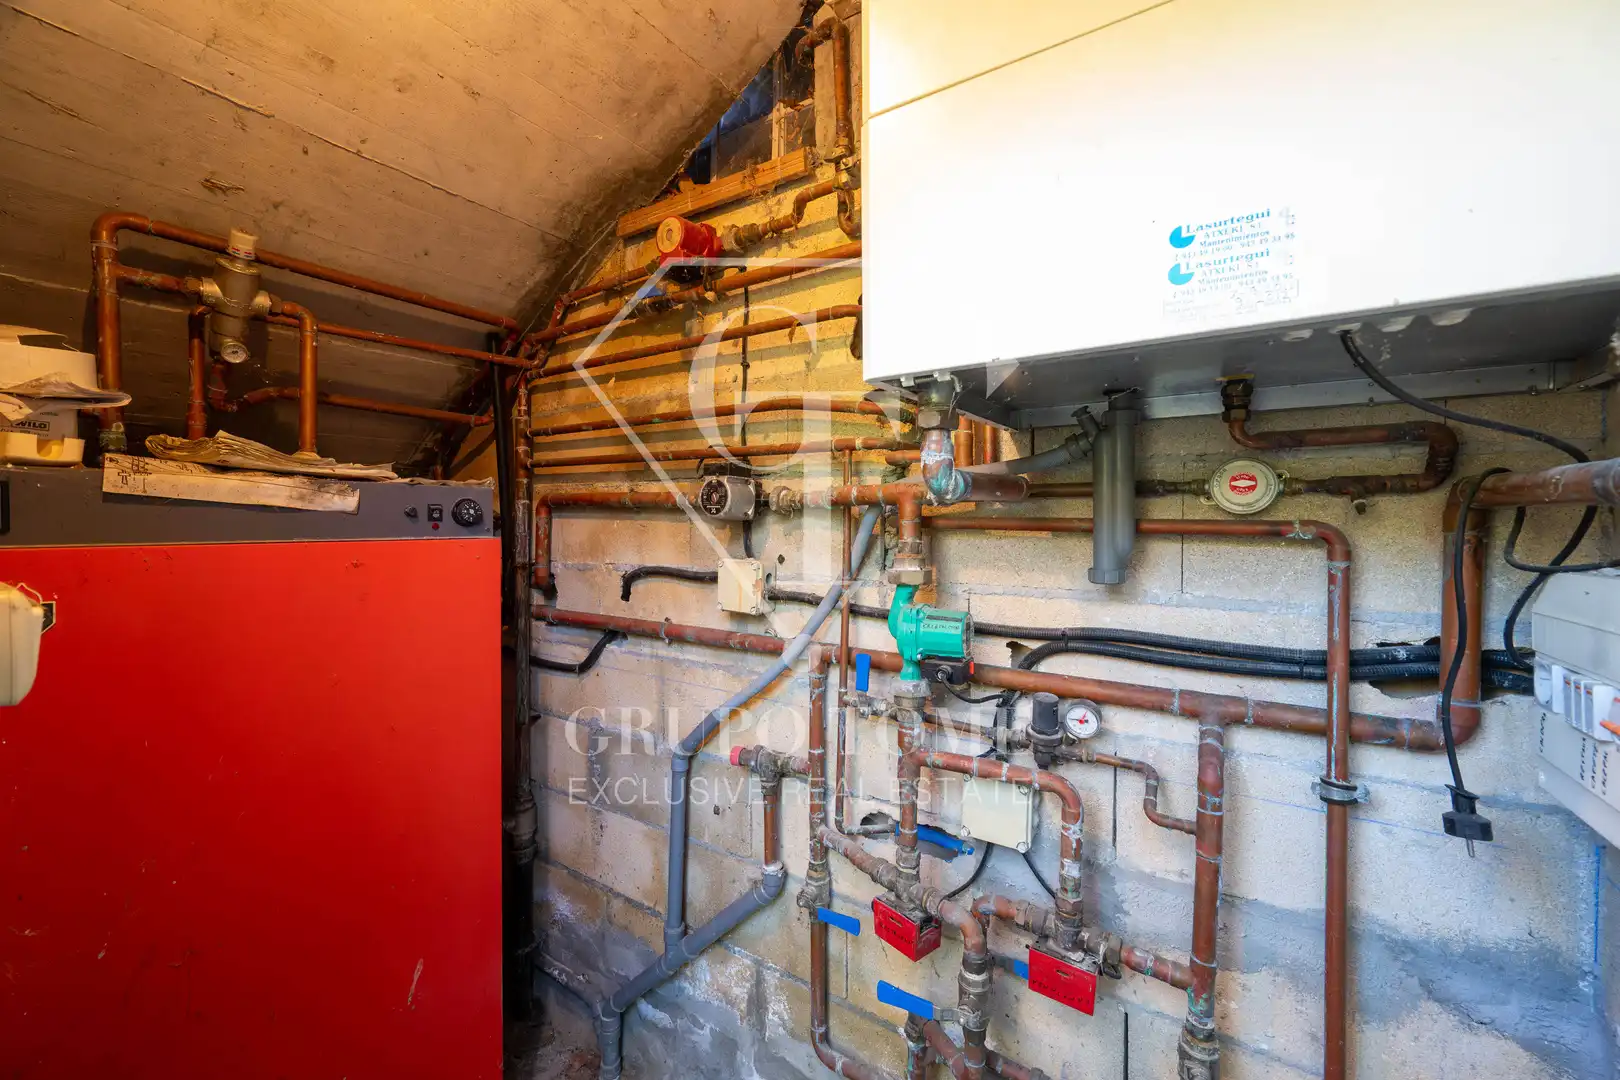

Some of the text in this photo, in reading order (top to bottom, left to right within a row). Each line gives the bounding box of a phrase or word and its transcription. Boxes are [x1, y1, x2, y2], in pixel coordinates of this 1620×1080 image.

[1184, 208, 1271, 234] Lasurtegui
[1199, 229, 1271, 248] Mantenimientos
[1184, 248, 1271, 271] Lasurtegui
